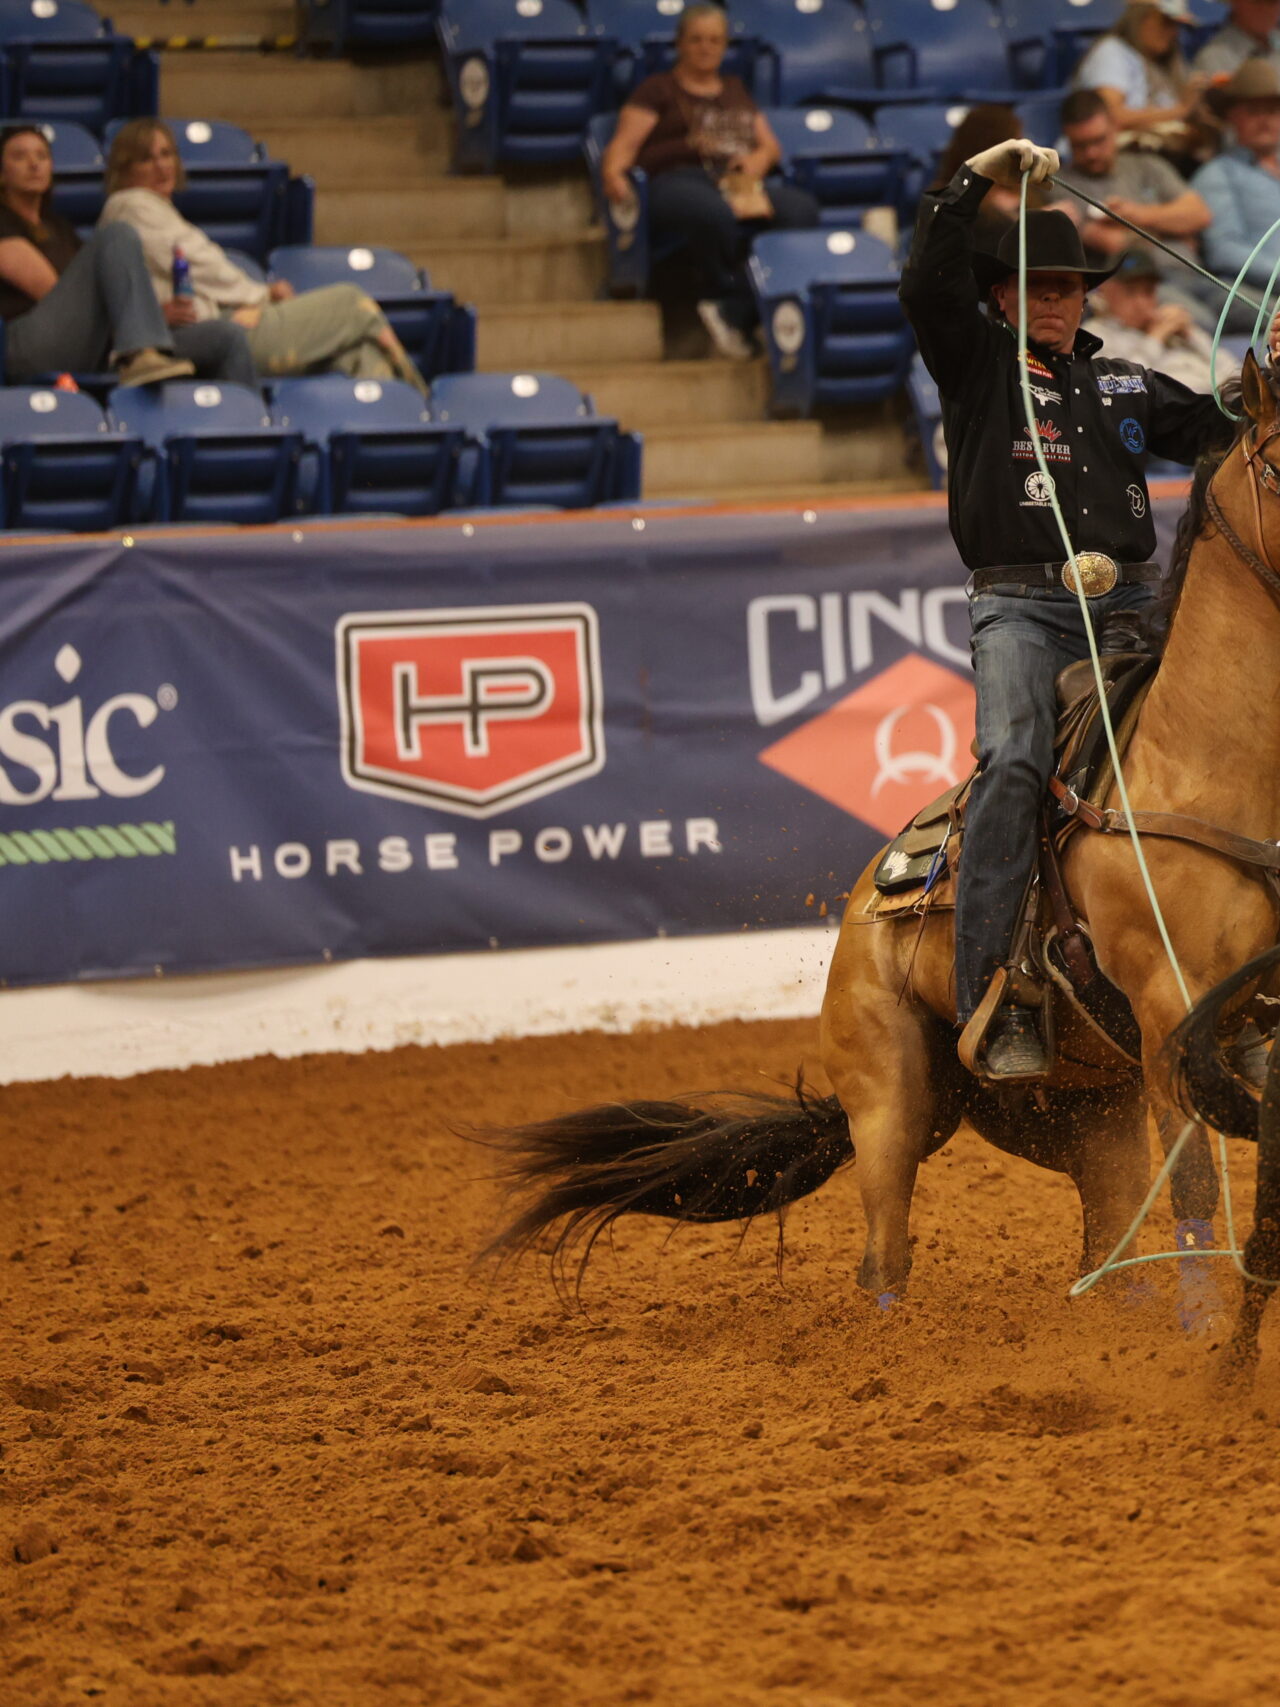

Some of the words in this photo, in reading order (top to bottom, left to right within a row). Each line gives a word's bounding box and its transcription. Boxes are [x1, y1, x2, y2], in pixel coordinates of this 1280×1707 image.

[1013, 441, 1037, 452] BES
[1042, 443, 1071, 455] EVER
[747, 587, 977, 727] CINC
[392, 655, 556, 761] HP
[229, 832, 459, 882] HORSE
[488, 817, 723, 867] POWER
